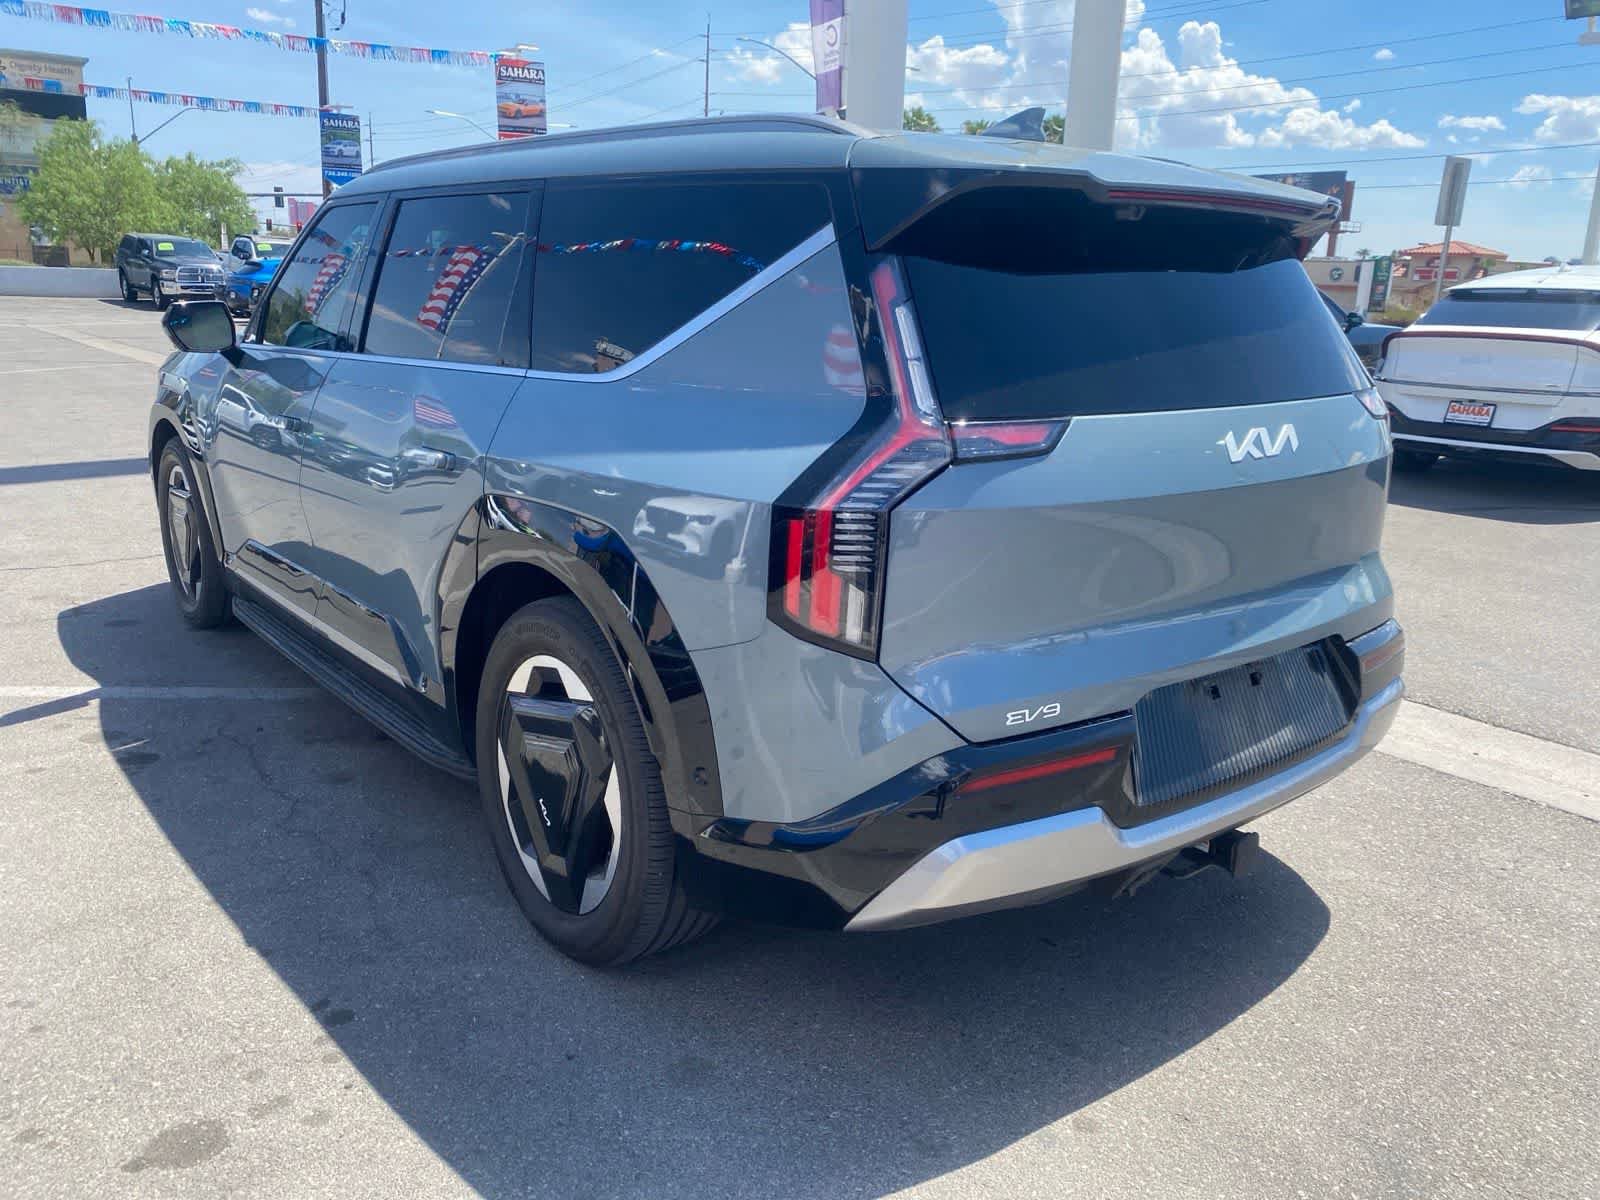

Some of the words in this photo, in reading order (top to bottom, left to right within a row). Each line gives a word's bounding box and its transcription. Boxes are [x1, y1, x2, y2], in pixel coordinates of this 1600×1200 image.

[500, 65, 545, 80] SAHARA
[323, 118, 360, 129] SAHARA
[1449, 404, 1490, 417] SAHARA
[1006, 703, 1061, 726] EV9
